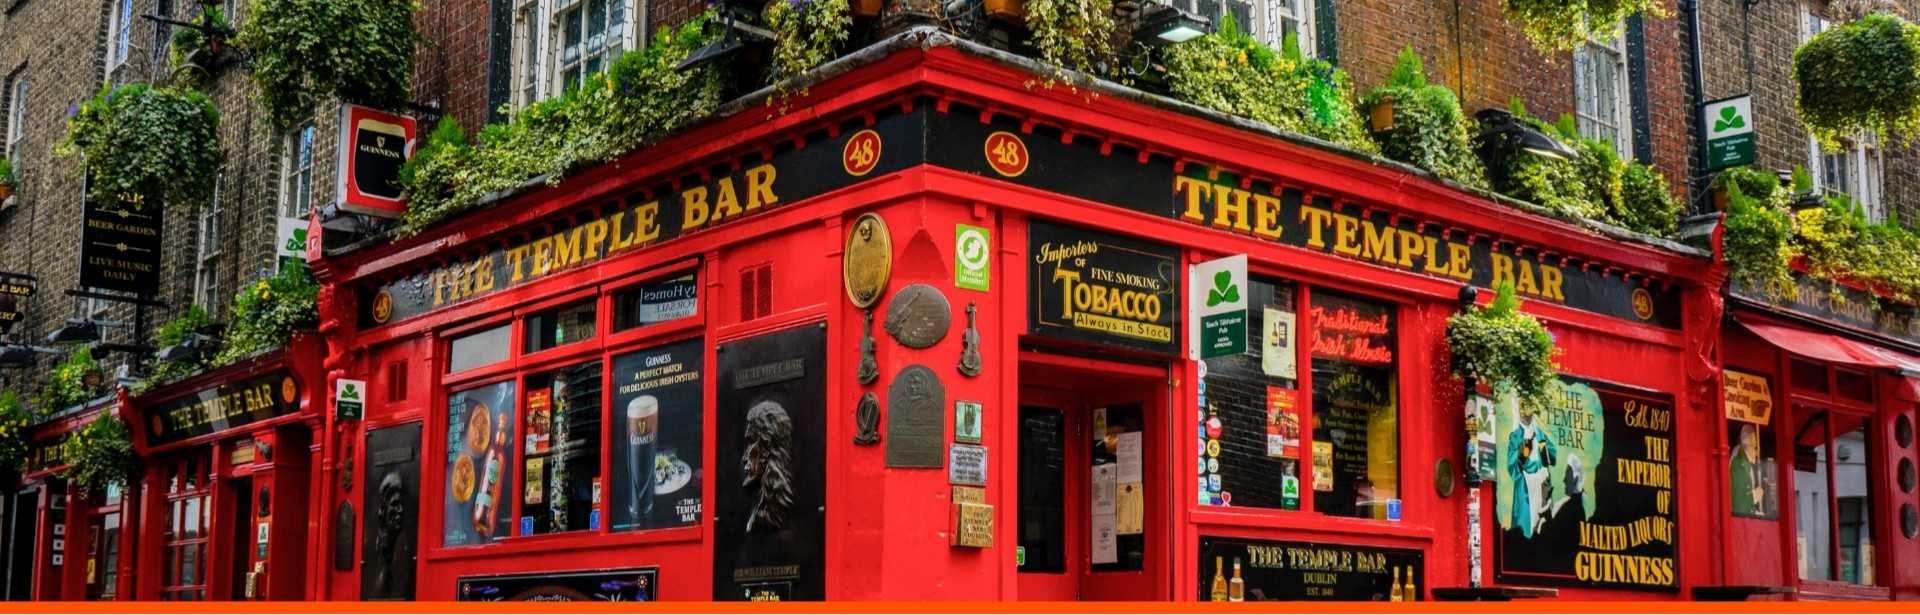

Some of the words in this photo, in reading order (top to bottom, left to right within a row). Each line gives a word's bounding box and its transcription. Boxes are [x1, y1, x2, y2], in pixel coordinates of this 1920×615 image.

[360, 144, 400, 159] GUINNESS
[849, 138, 874, 168] 48
[992, 137, 1020, 168] 48
[88, 219, 114, 230] BEER
[116, 223, 157, 236] GARDEN
[431, 255, 495, 305] THE
[506, 200, 661, 282] TEMPLE
[681, 163, 778, 230] BAR
[1176, 175, 1283, 238] THE
[1300, 205, 1473, 281] TEMPLE
[1490, 252, 1565, 301] BAR
[89, 256, 116, 267] LIVE
[117, 260, 152, 272] MUSIC
[1036, 240, 1098, 271] Importers
[1075, 257, 1086, 268] OF
[103, 270, 137, 281] DAILY
[961, 275, 984, 285] Member
[963, 268, 983, 277] Official
[1091, 267, 1115, 283] FINE
[1115, 271, 1161, 291] SMOKING
[10, 285, 30, 295] BAR
[1053, 268, 1161, 322] TOBACCO
[376, 297, 389, 317] 48
[1635, 294, 1649, 313] 48
[1075, 312, 1118, 331] Always
[1123, 321, 1133, 333] in
[1137, 323, 1169, 340] Stock
[1205, 320, 1219, 329] Teach
[1310, 306, 1389, 335] Traditional
[1213, 341, 1233, 349] APPROVED
[1310, 329, 1346, 356] Irish
[1350, 337, 1392, 363] Music
[645, 353, 671, 368] GUINNESS
[751, 363, 783, 378] TEMPLE
[785, 359, 802, 372] BAR
[619, 385, 630, 394] FOR
[630, 379, 658, 393] DELICIOUS
[658, 375, 674, 387] IRISH
[674, 370, 699, 385] OYSTERS
[634, 370, 640, 380] A
[639, 366, 662, 379] PERFECT
[662, 363, 683, 374] MATCH
[1327, 373, 1362, 394] TEMPLE
[1365, 379, 1382, 402] BAR
[1724, 373, 1739, 389] Beer
[1739, 376, 1762, 394] Garden
[170, 406, 194, 431] THE
[194, 391, 243, 425] TEMPLE
[244, 383, 274, 412] BAR
[1556, 390, 1583, 411] THE
[1723, 388, 1751, 408] Smoking
[1544, 406, 1595, 432] TEMPLE
[1650, 408, 1670, 432] 1840
[1730, 404, 1745, 419] Area
[630, 433, 655, 446] GUINNESS
[1558, 427, 1585, 451] BAR
[1645, 435, 1670, 462] THE
[44, 445, 58, 463] THE
[1617, 458, 1671, 489] EMPEROR
[675, 504, 702, 515] TEMPLE
[1656, 490, 1671, 515] OF
[681, 514, 696, 522] BAR
[1579, 520, 1628, 550] MALTED
[1628, 515, 1674, 547] LIQUORS
[1247, 545, 1283, 568] THE
[1287, 548, 1352, 572] TEMPLE
[1356, 552, 1388, 573] BAR
[1574, 551, 1674, 586] GUINNESS
[1303, 572, 1337, 584] DUBLIN
[1321, 587, 1334, 596] 1840
